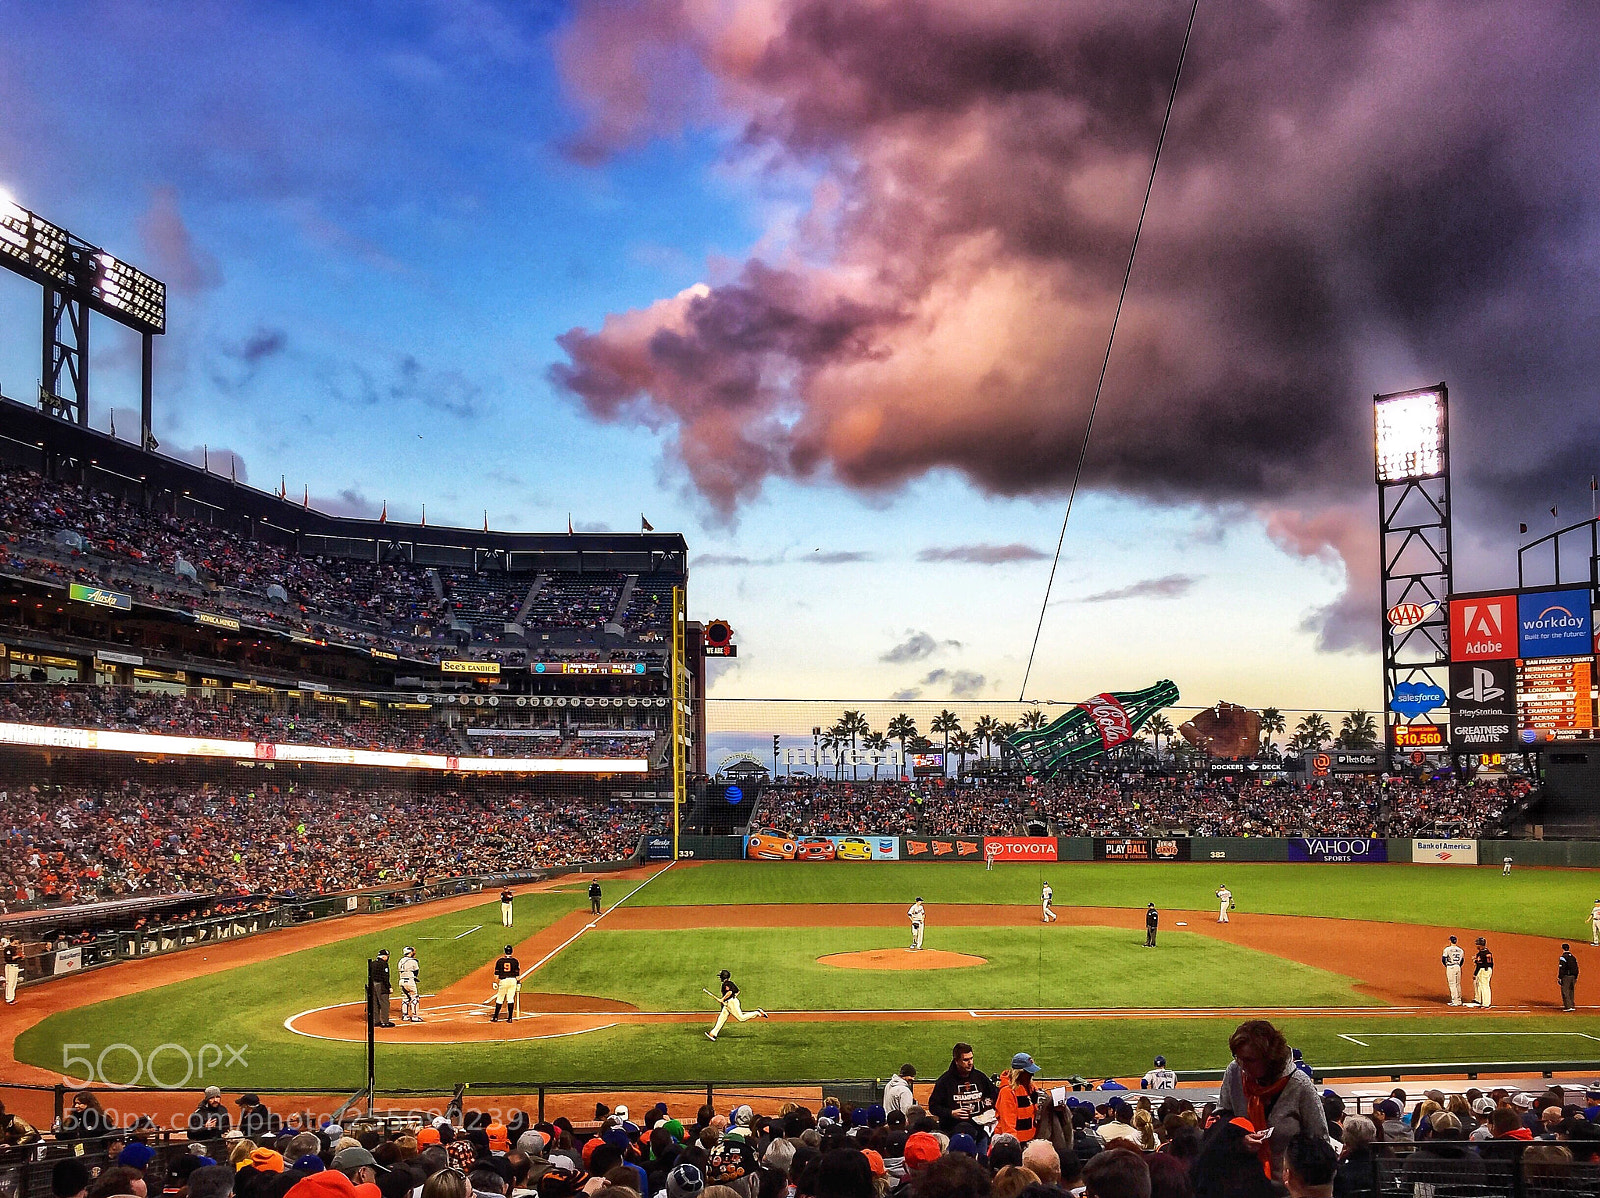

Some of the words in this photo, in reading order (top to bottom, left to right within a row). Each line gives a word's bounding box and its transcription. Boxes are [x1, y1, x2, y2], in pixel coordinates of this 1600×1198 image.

[88, 590, 118, 606] Alaska
[1392, 604, 1421, 625] AAA
[1524, 616, 1584, 629] workday
[1465, 642, 1502, 654] Adobe
[444, 662, 466, 671] See's
[1398, 693, 1440, 703] salesforce
[1460, 709, 1503, 718] PlayStation
[1454, 725, 1509, 735] GREATNESS
[1396, 733, 1441, 746] $10,560
[1464, 734, 1500, 743] AWAITS
[1005, 844, 1056, 854] TOYOTA
[1106, 845, 1126, 854] PLAY
[1127, 845, 1147, 854] BALL
[1304, 838, 1370, 855] YAHOO!
[679, 850, 694, 858] 339
[503, 962, 511, 972] 9
